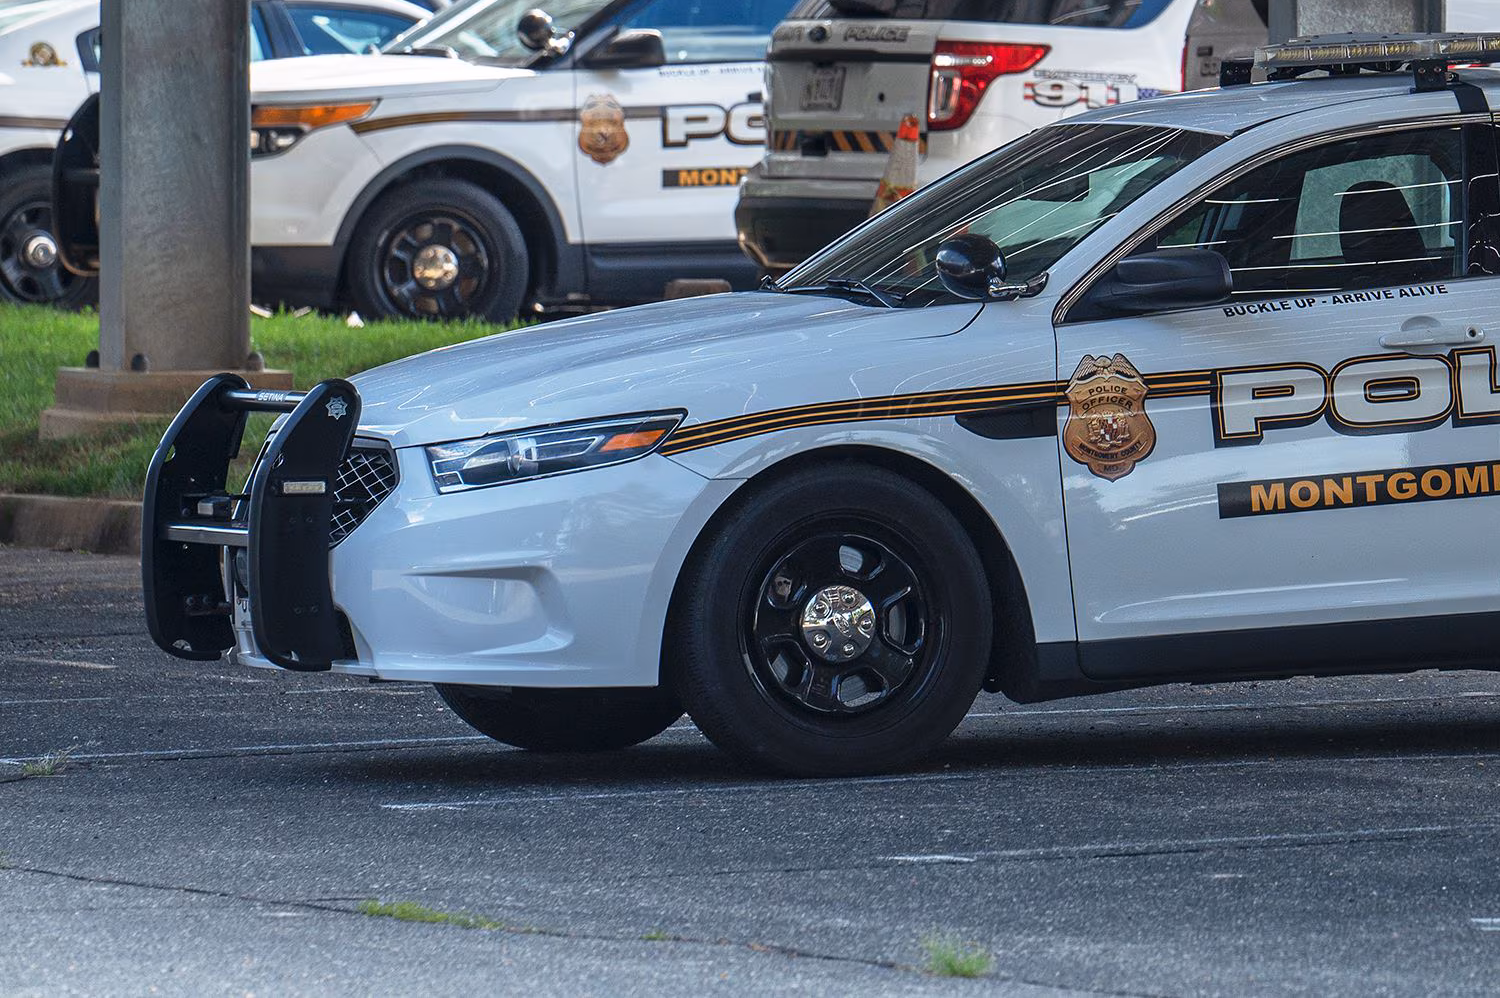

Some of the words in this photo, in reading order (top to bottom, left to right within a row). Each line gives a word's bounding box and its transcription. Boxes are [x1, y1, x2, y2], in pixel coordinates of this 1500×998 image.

[1222, 300, 1292, 318] BUCKLE
[1296, 297, 1316, 309] UP
[1331, 289, 1395, 305] ARRIVE
[1399, 284, 1449, 299] ALIVE
[257, 392, 285, 402] SETINA
[1087, 385, 1129, 396] POLICE
[1081, 395, 1134, 411] OFFICER
